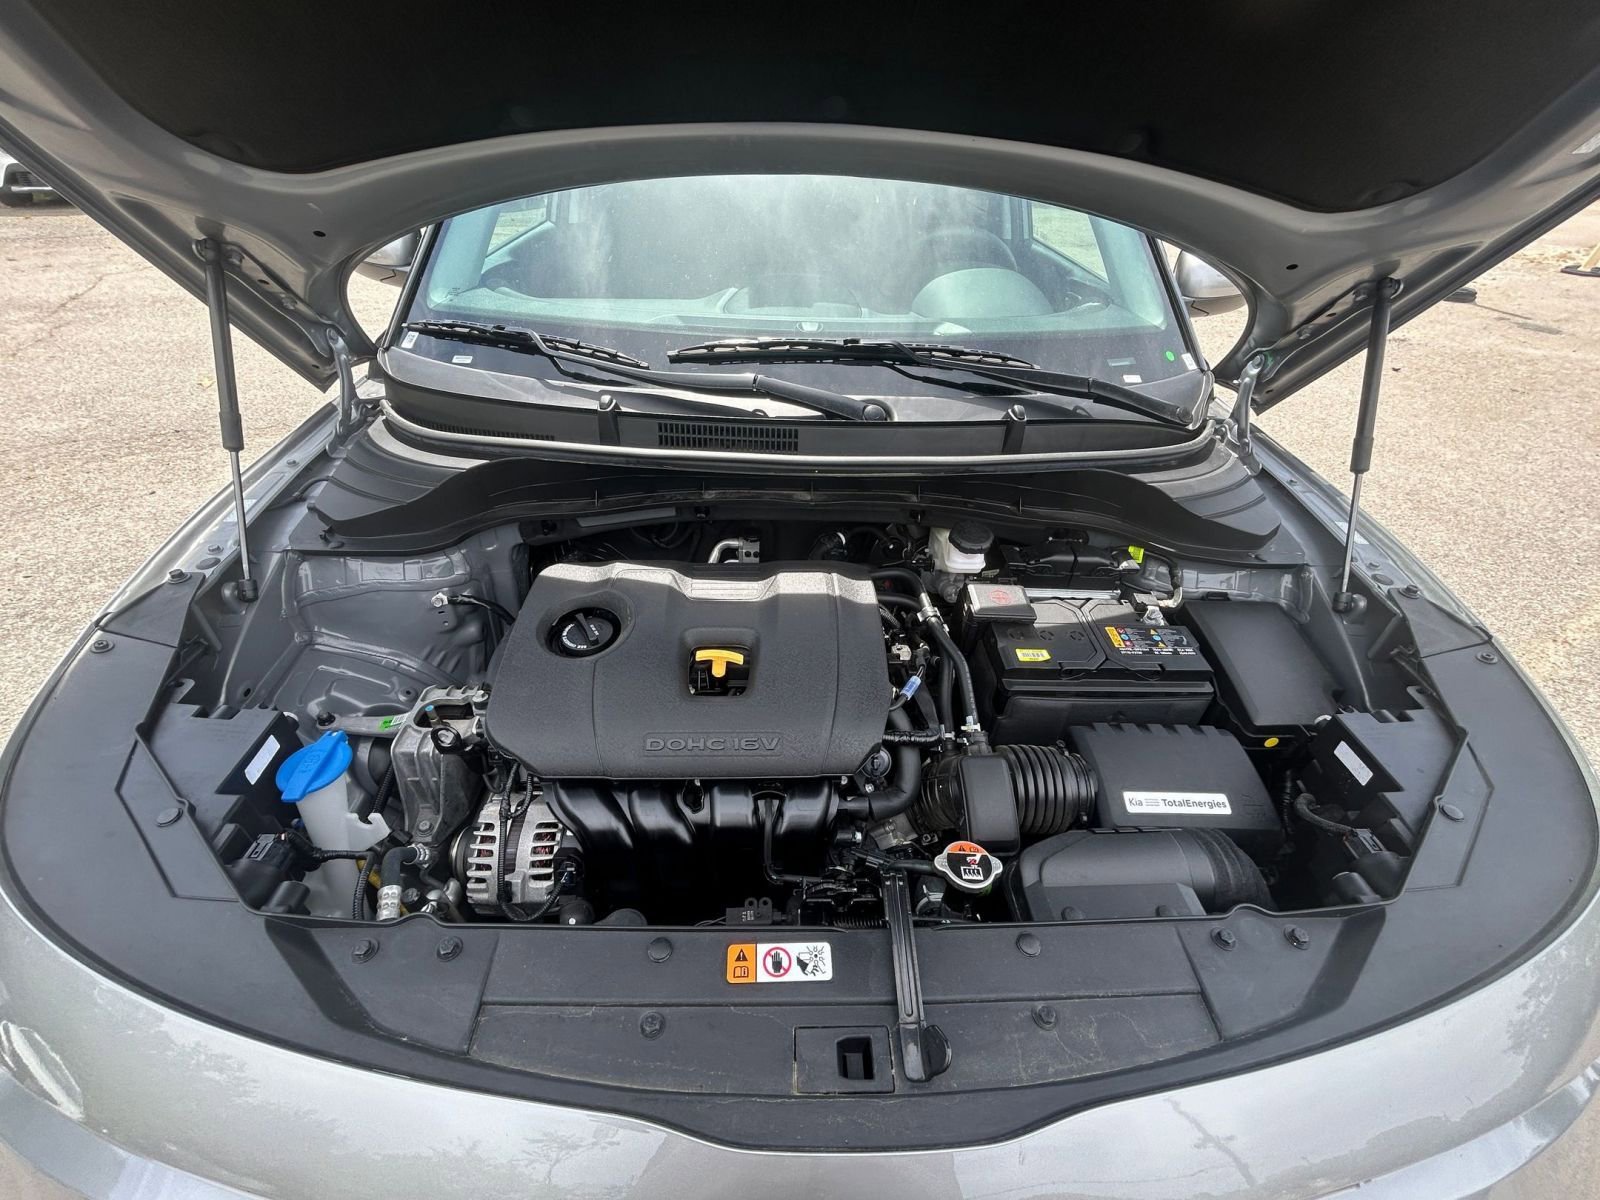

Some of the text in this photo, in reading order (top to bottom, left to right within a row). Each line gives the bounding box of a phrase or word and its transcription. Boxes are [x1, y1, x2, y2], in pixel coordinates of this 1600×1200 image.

[646, 737, 781, 751] DOHC 16V
[1128, 797, 1228, 810] Kia TotalEnergies
